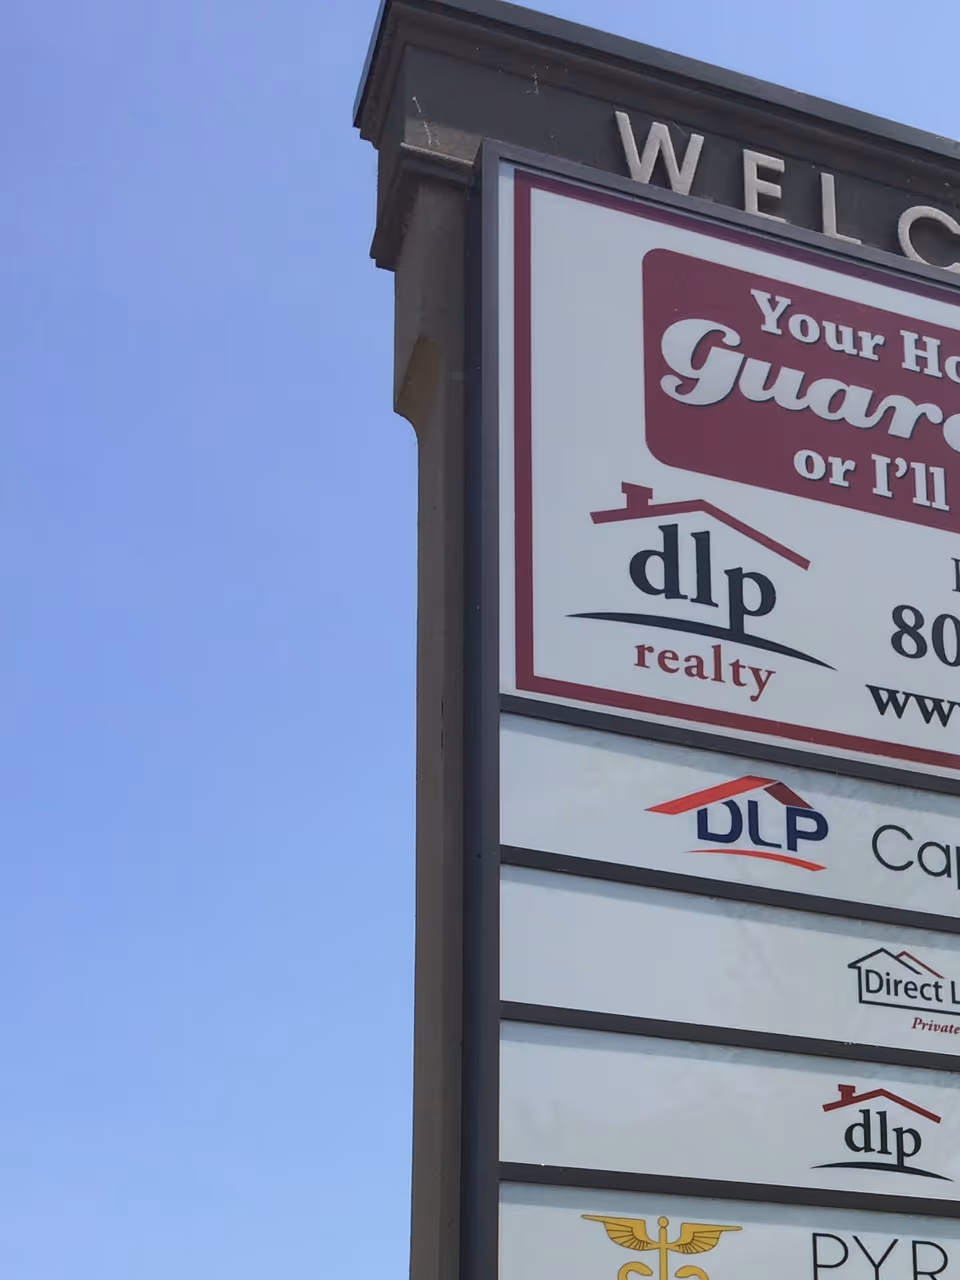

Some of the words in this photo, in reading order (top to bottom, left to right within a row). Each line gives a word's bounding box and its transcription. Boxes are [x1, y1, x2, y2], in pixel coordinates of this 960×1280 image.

[750, 289, 884, 363] Your
[793, 445, 856, 489] or
[629, 523, 777, 640] dlp
[633, 639, 777, 703] realty
[697, 799, 829, 852] DLP
[865, 969, 943, 1003] Direct
[911, 1017, 960, 1035] Private
[844, 1109, 922, 1167] dlp
